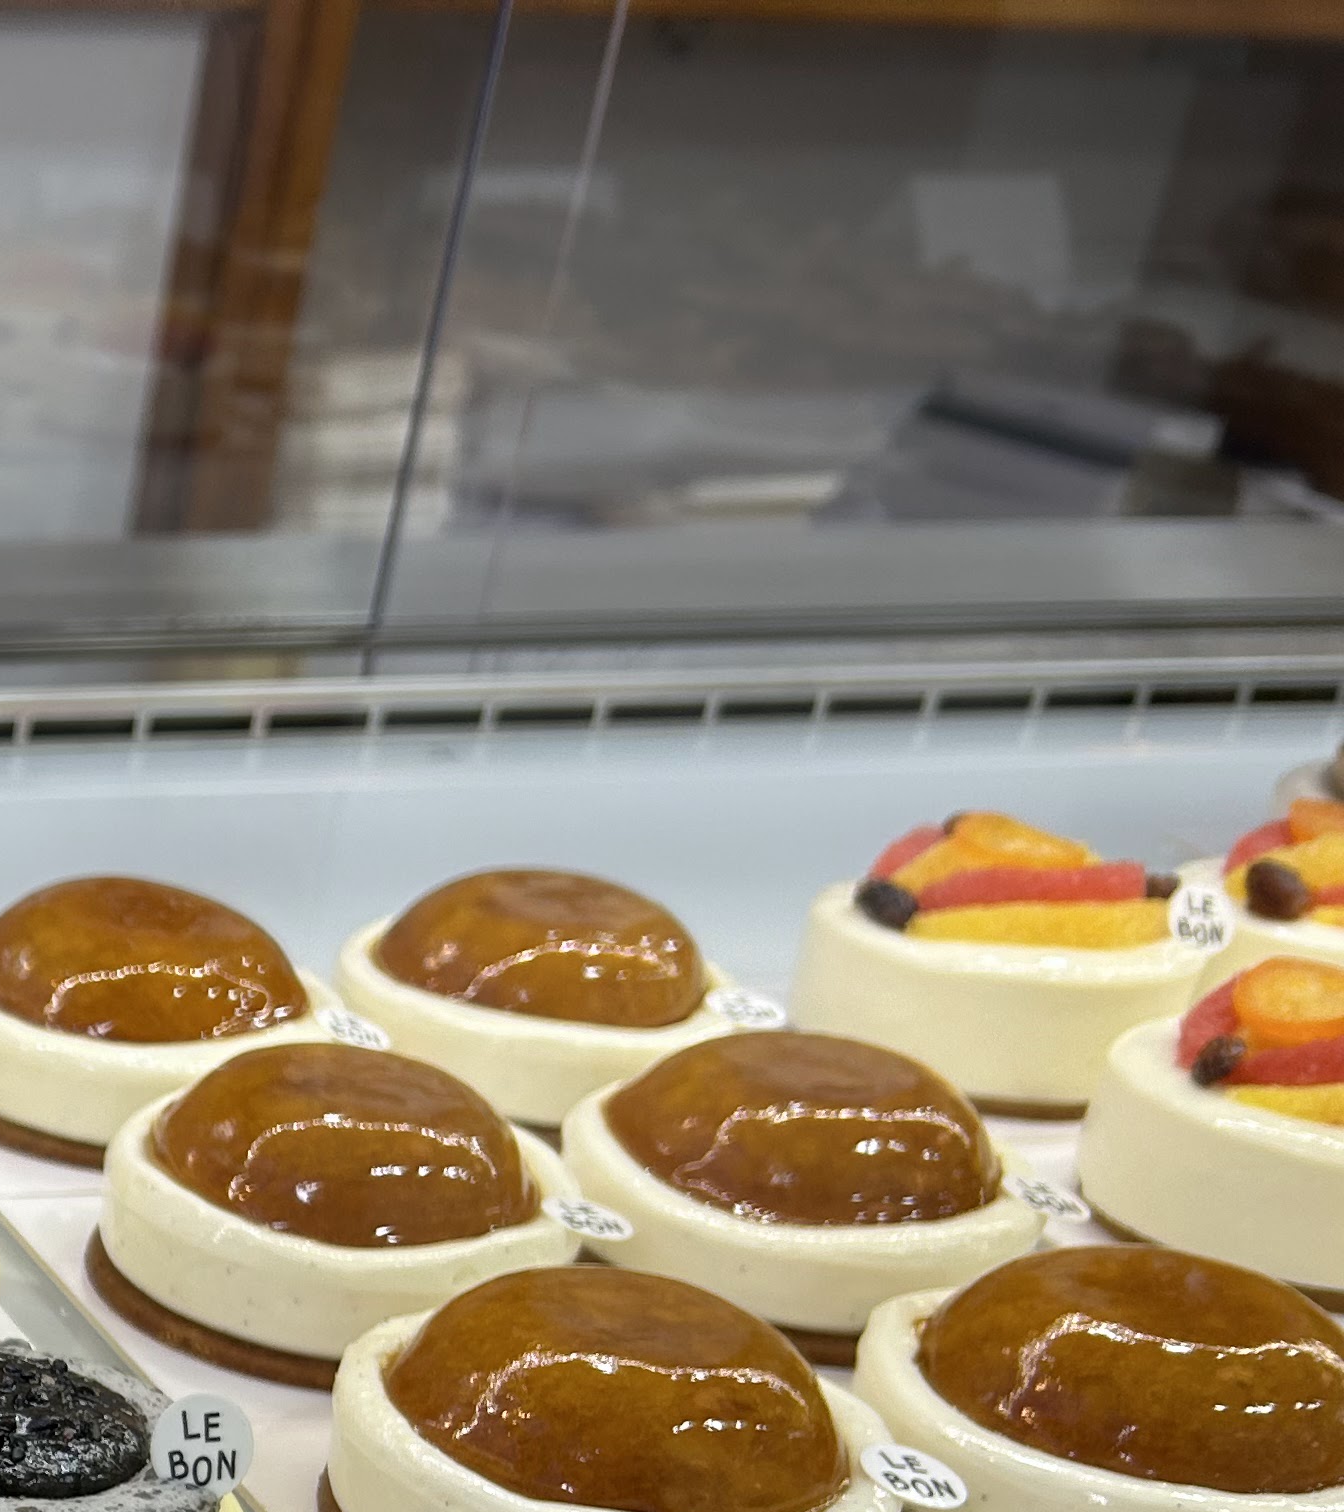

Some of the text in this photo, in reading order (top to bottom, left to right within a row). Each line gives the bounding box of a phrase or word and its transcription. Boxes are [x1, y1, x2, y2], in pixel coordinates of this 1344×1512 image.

[1186, 890, 1214, 915] LE
[1177, 921, 1224, 944] BON
[180, 1410, 221, 1442] LE
[167, 1450, 237, 1486] BON
[878, 1450, 928, 1475] LE
[882, 1471, 958, 1500] BON
